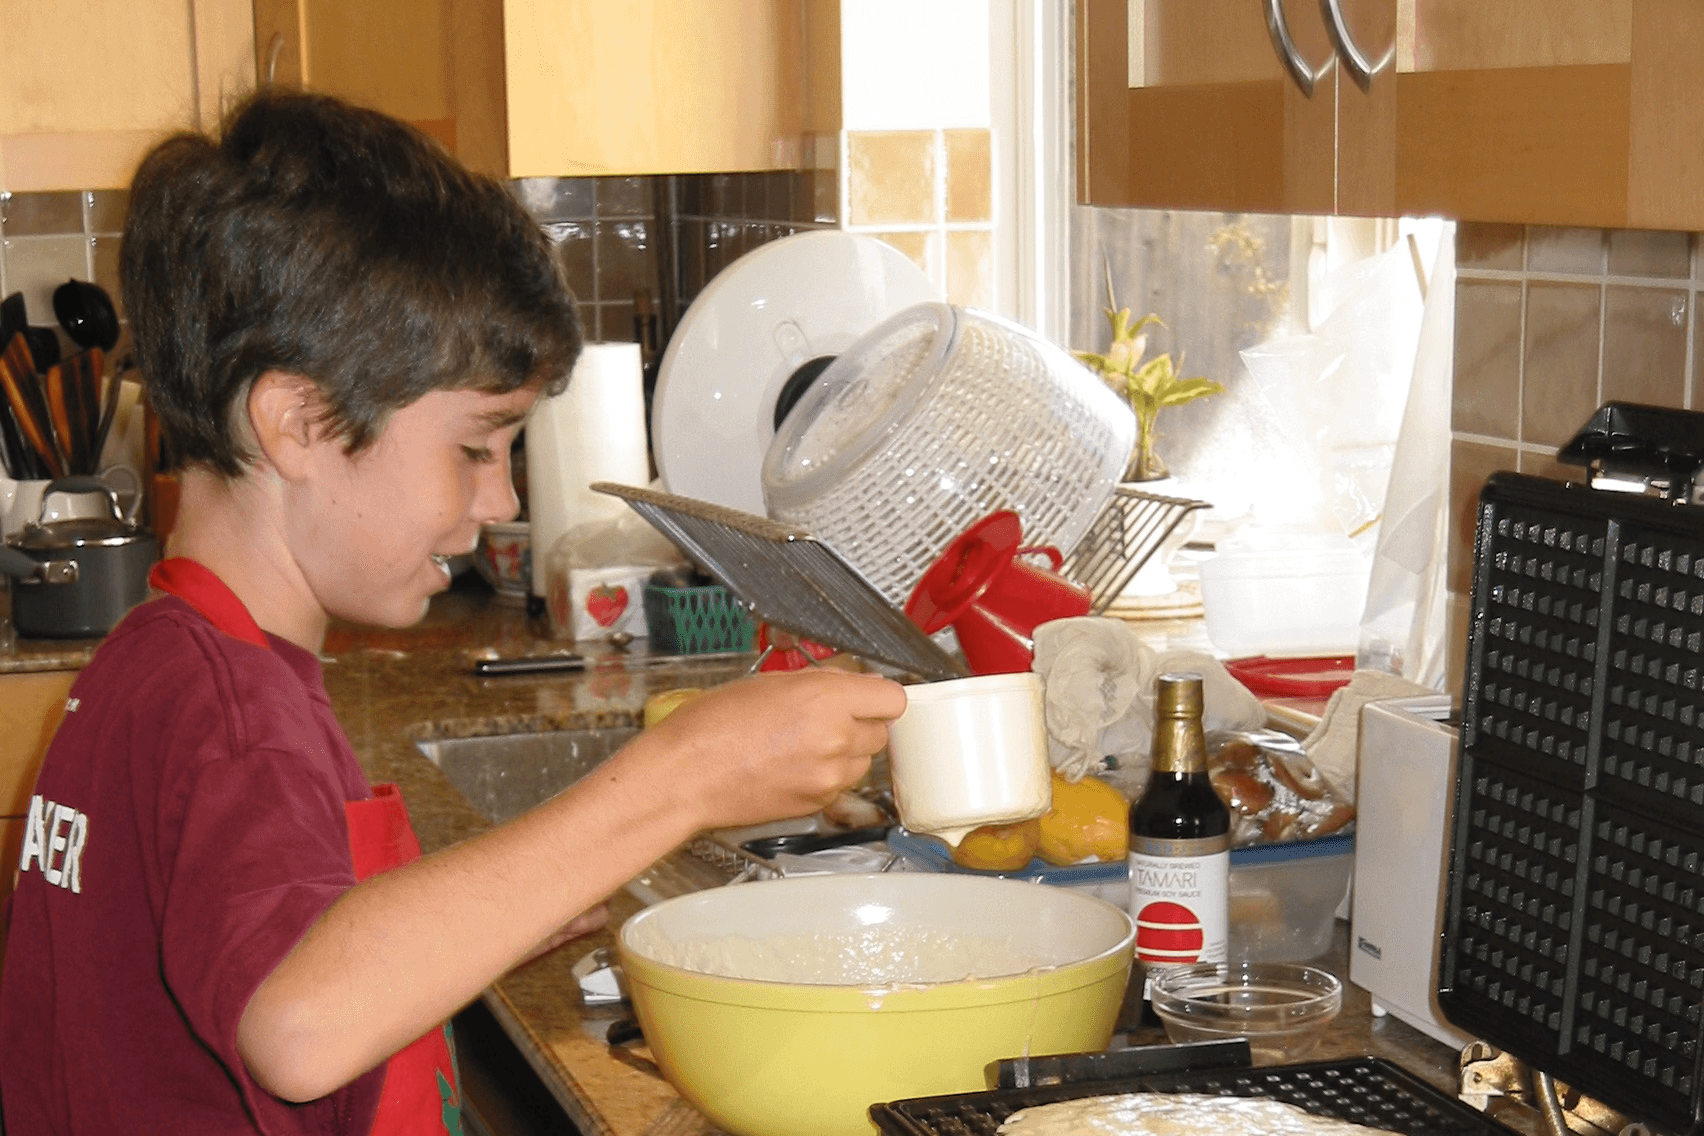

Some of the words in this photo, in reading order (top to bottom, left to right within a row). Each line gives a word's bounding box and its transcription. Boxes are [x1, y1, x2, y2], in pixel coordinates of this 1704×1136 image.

[1137, 868, 1197, 888] TAMARI
[1161, 890, 1177, 898] SOY
[1178, 890, 1201, 898] SAUCE
